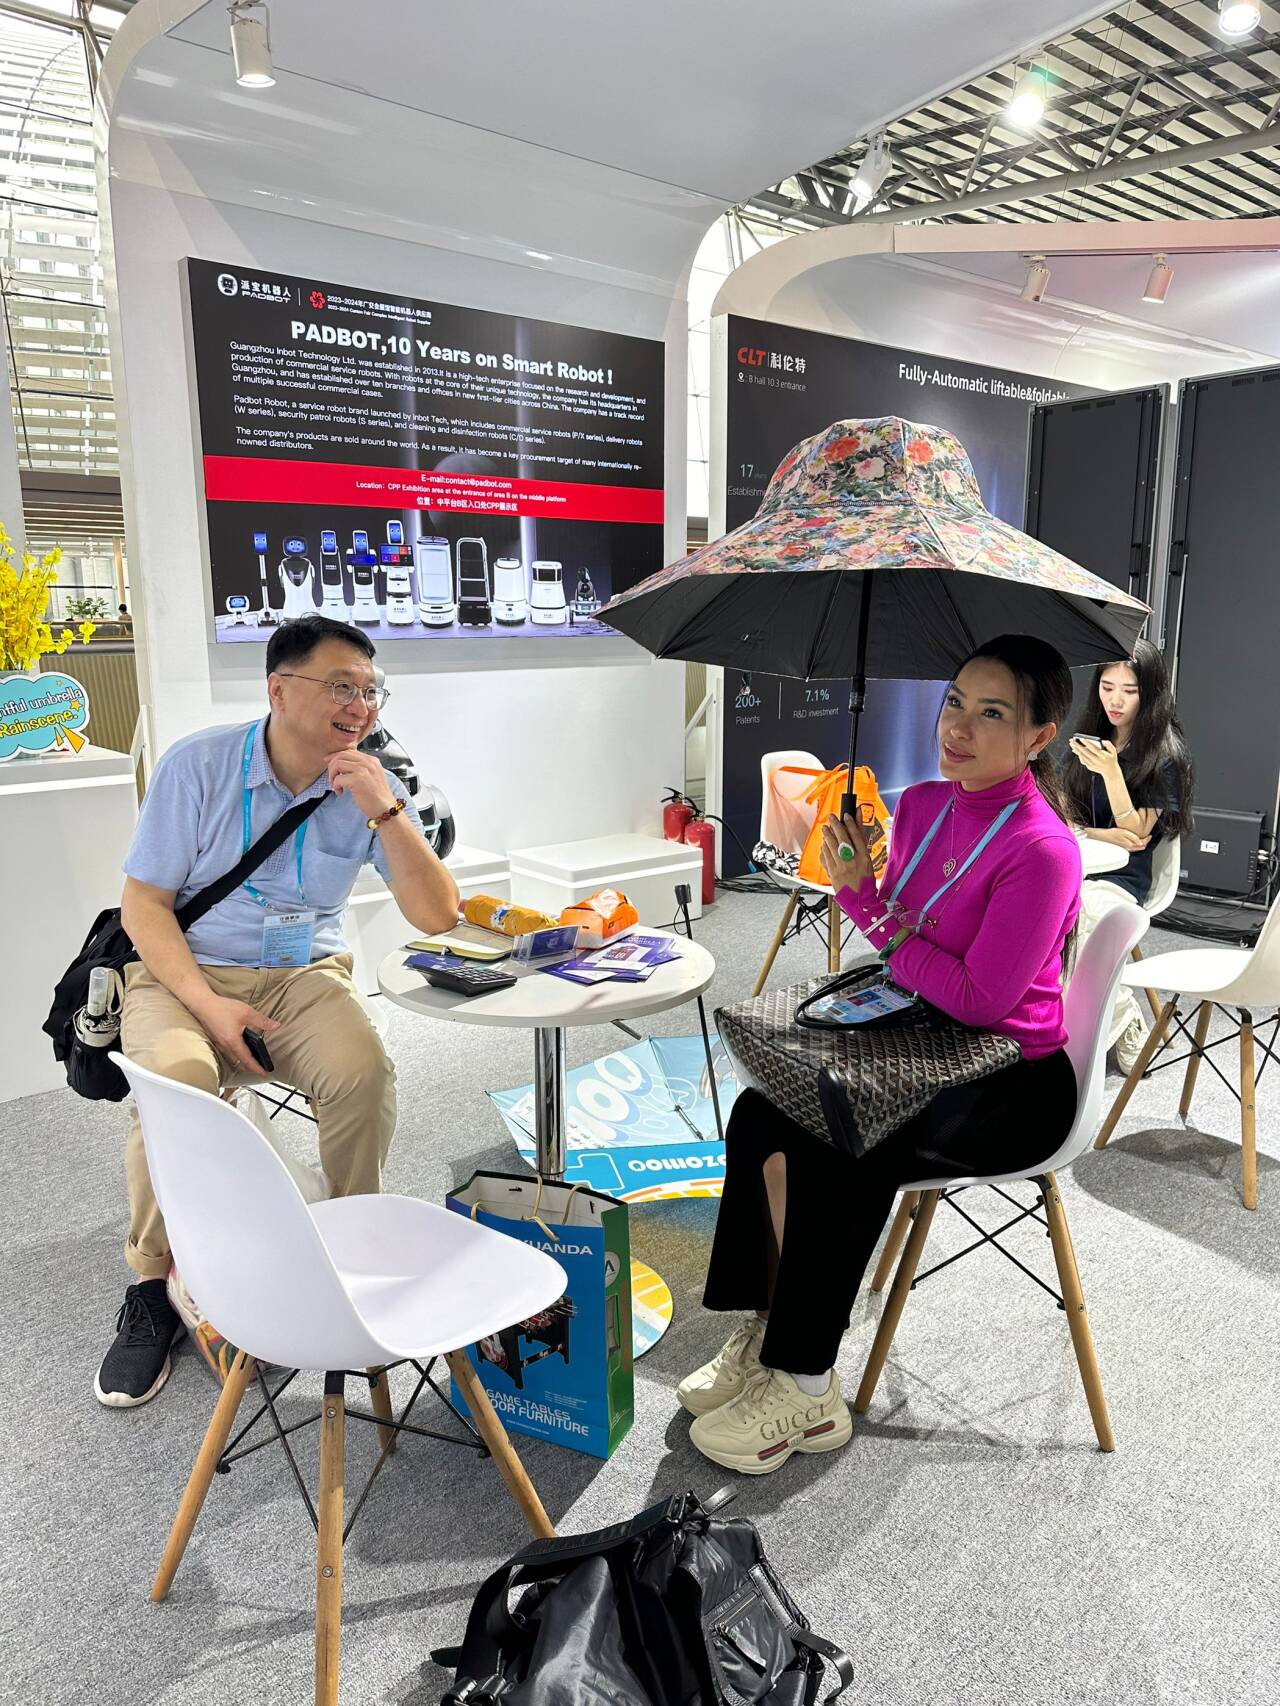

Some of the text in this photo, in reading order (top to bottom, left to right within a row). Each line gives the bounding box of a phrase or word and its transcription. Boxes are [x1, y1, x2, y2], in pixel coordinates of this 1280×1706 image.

[241, 279, 291, 297] 派宝机器人
[242, 290, 291, 304] PADBOT
[291, 320, 612, 385] PADBOT,10 Years on Smart Robot !
[737, 347, 766, 366] CLT
[770, 352, 806, 373] 科伦特
[754, 376, 766, 385] hall
[780, 381, 806, 391] entrance
[898, 364, 988, 394] Fully-Automatic
[740, 464, 754, 478] 17
[28, 686, 84, 709] umbrella
[736, 694, 761, 708] 200+
[806, 688, 830, 702] 7.1%
[736, 716, 760, 725] Patents
[793, 708, 839, 718] R&D investment
[486, 1388, 521, 1407] GAME
[523, 1400, 571, 1420] TABLES
[518, 1407, 590, 1436] FURNITURE
[760, 1403, 826, 1441] GUCCI
